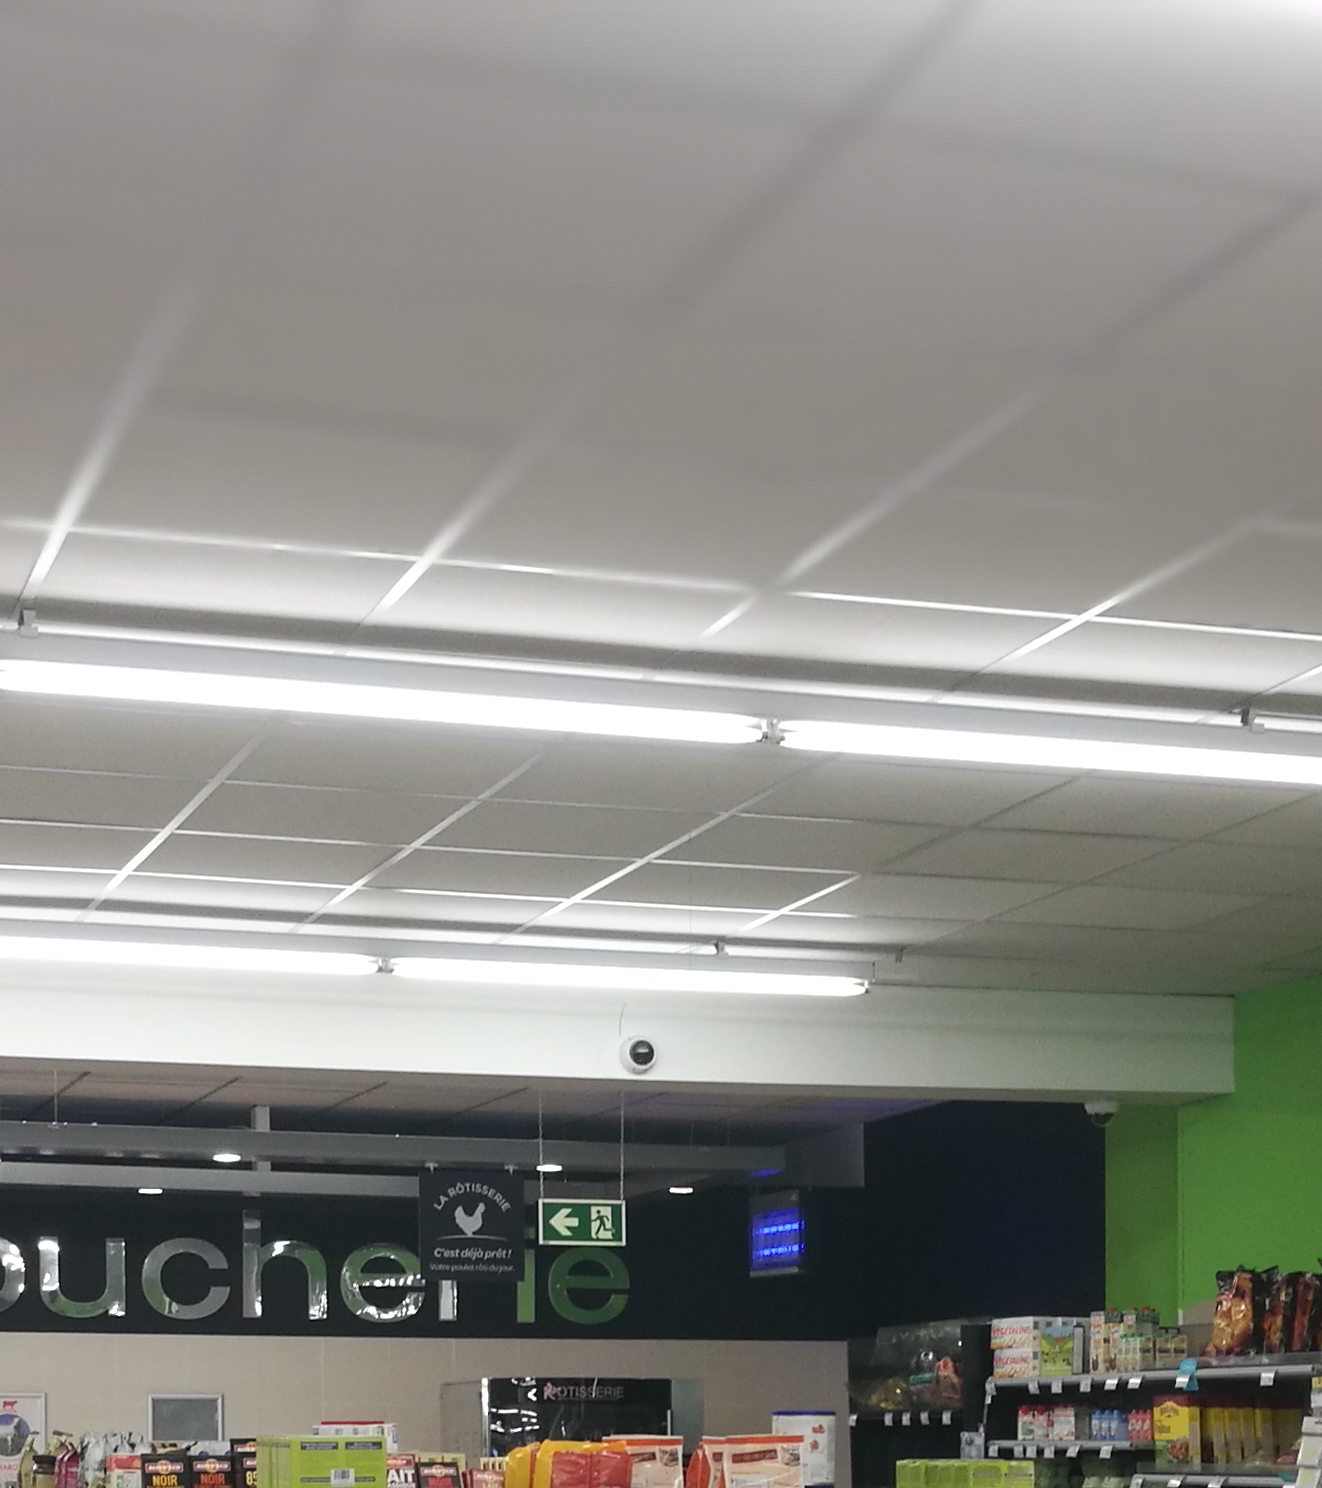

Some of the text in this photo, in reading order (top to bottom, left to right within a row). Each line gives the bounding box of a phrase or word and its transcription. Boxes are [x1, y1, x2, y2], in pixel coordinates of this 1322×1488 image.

[433, 1182, 512, 1212] LA RÔTISSERIE
[434, 1247, 460, 1258] C'est
[461, 1247, 484, 1260] déjà
[484, 1248, 506, 1260] prêt
[152, 1474, 178, 1486] NOIR
[200, 1473, 225, 1485] NOIR
[387, 1468, 415, 1482] AIT
